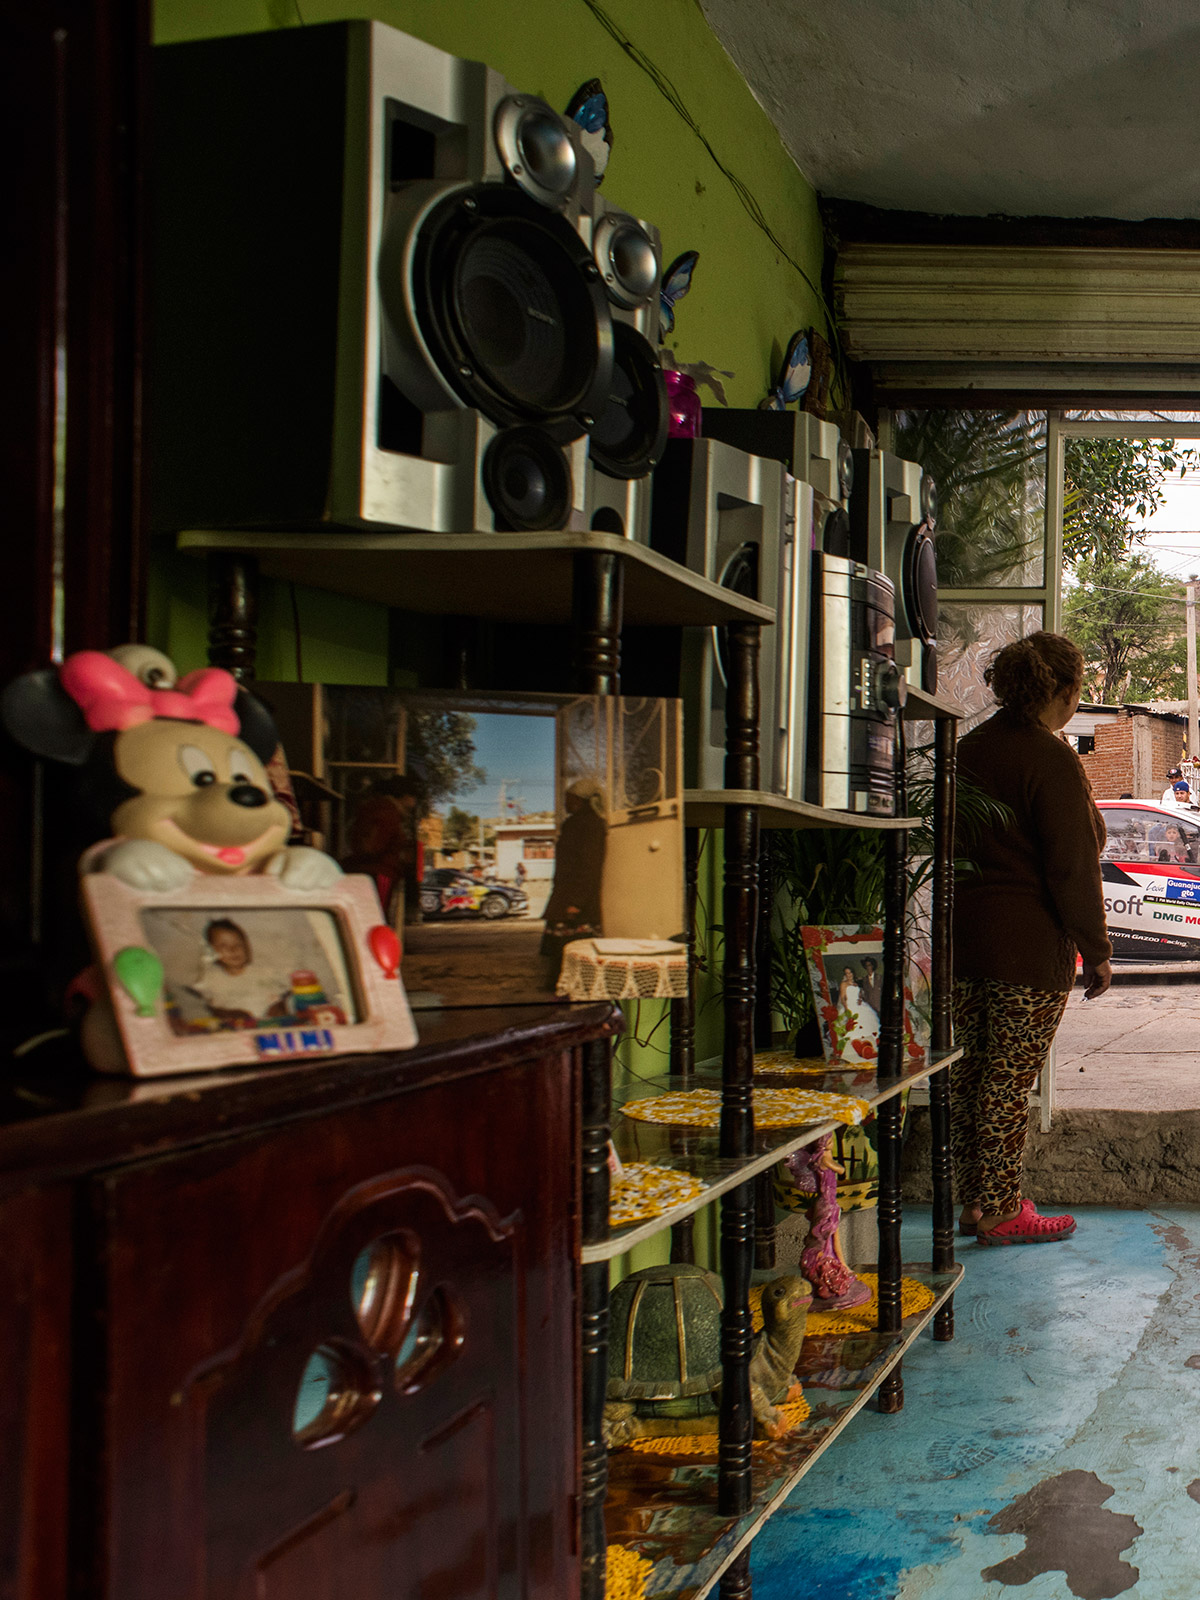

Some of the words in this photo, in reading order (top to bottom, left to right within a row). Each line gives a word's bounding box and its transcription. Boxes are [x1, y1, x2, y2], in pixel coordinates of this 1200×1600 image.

[1181, 889, 1195, 897] gto
[1104, 895, 1143, 916] soft
[1153, 911, 1183, 922] DMG
[1107, 931, 1130, 939] OYOTA
[1131, 933, 1160, 943] GAZOO
[1160, 937, 1187, 948] Racing
